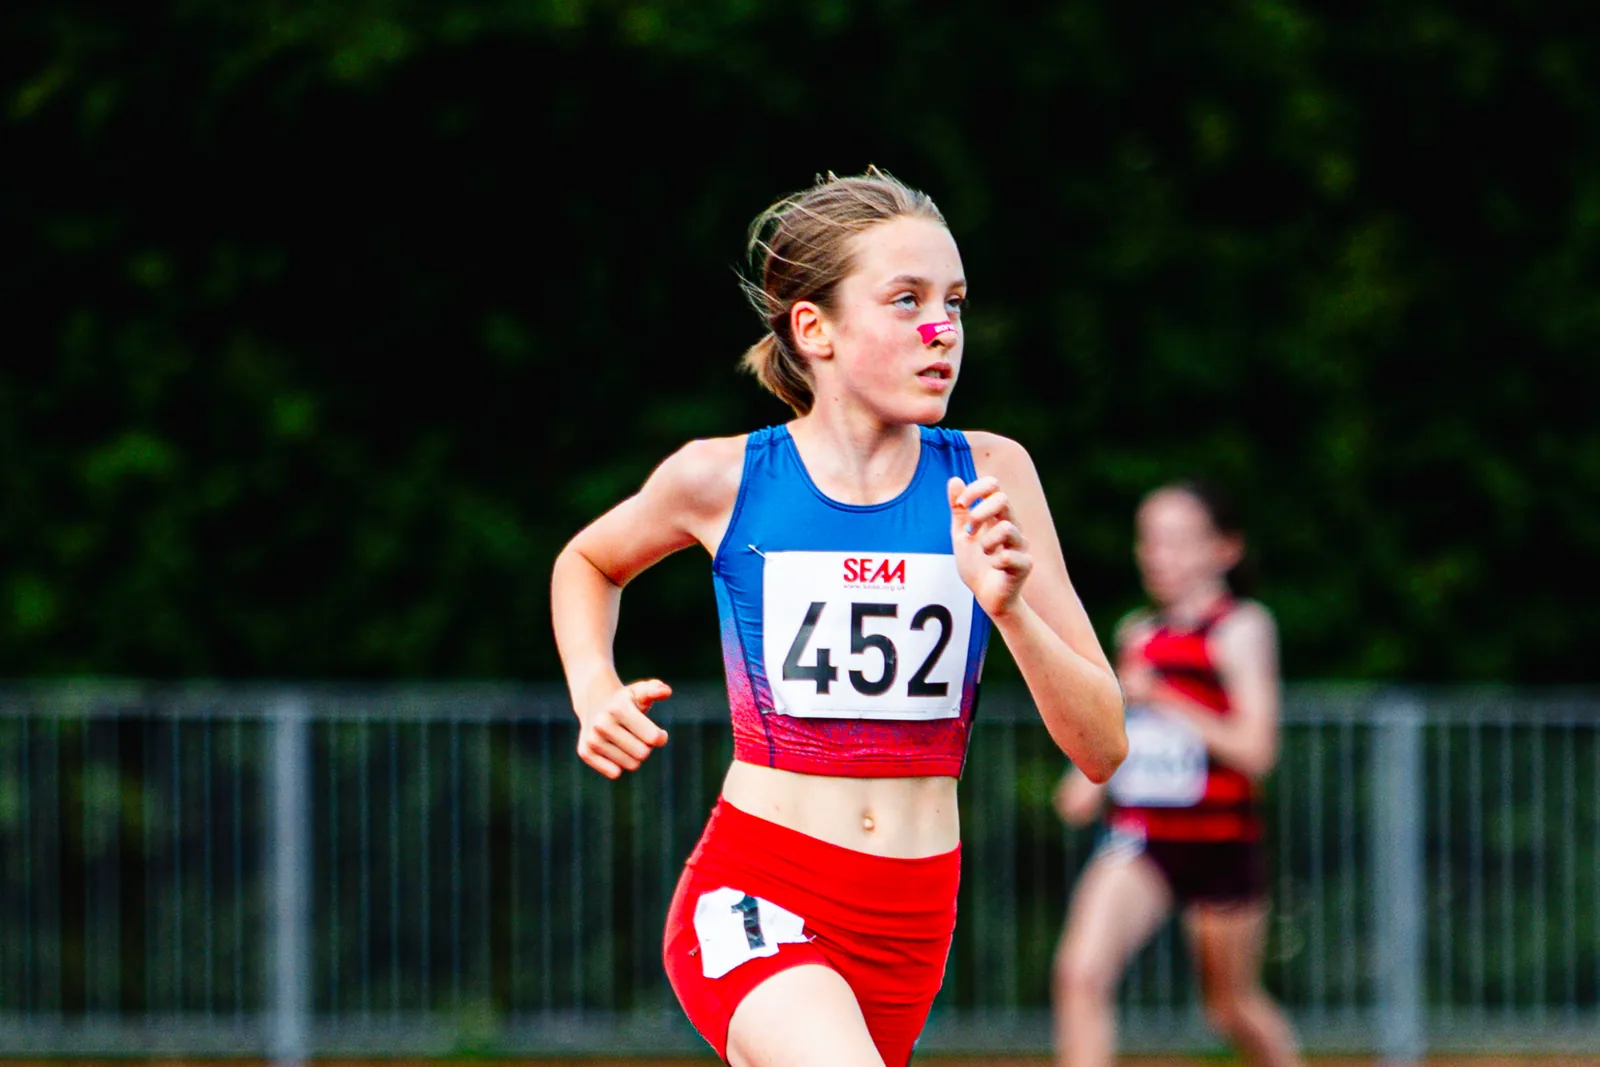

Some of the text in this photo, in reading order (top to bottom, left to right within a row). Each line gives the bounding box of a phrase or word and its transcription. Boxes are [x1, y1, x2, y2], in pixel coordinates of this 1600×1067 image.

[843, 557, 906, 584] SEAA
[782, 601, 954, 697] 452
[730, 894, 767, 951] 1
